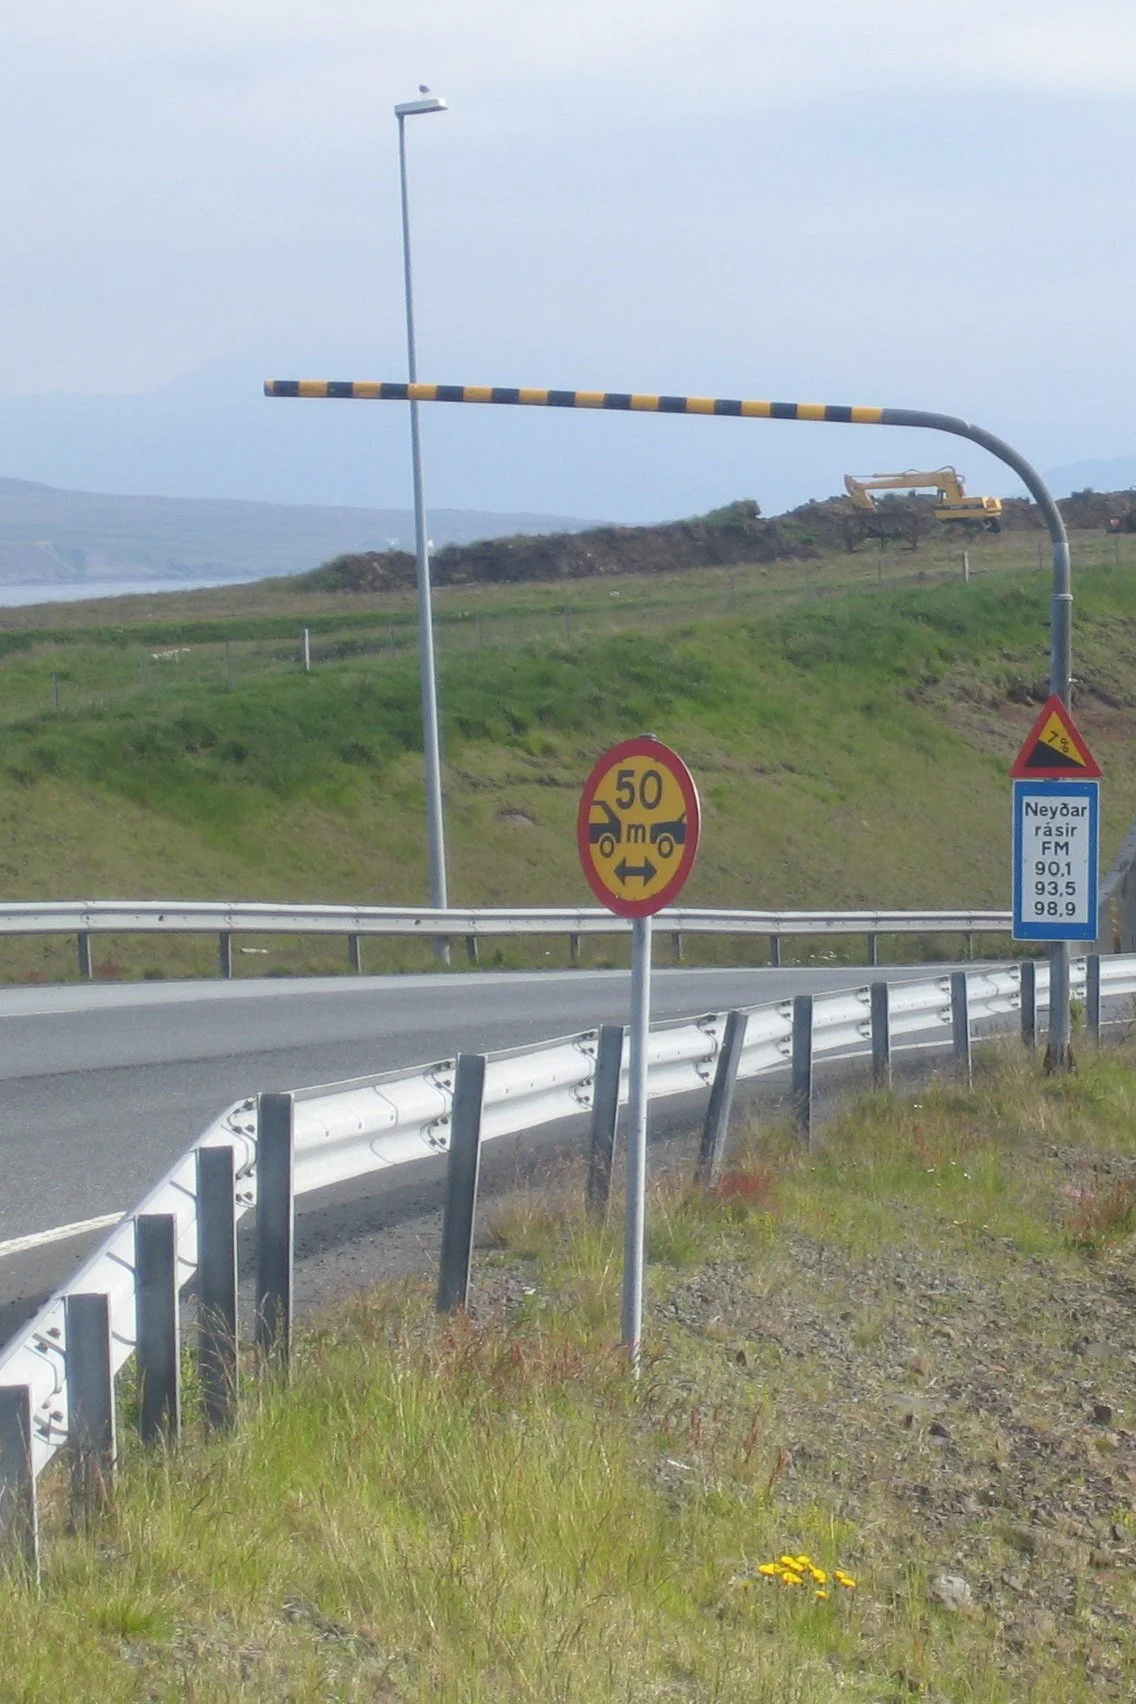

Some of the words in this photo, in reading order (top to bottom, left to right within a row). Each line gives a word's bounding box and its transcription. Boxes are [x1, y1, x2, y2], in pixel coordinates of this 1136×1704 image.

[615, 769, 662, 810] 50
[1025, 801, 1087, 820] Neyðar
[627, 823, 646, 843] m
[1035, 821, 1077, 837] rásir
[1041, 841, 1069, 855] FM
[1035, 861, 1071, 877] 90,1
[1035, 881, 1076, 897] 93,5
[1034, 901, 1076, 917] 98,9
